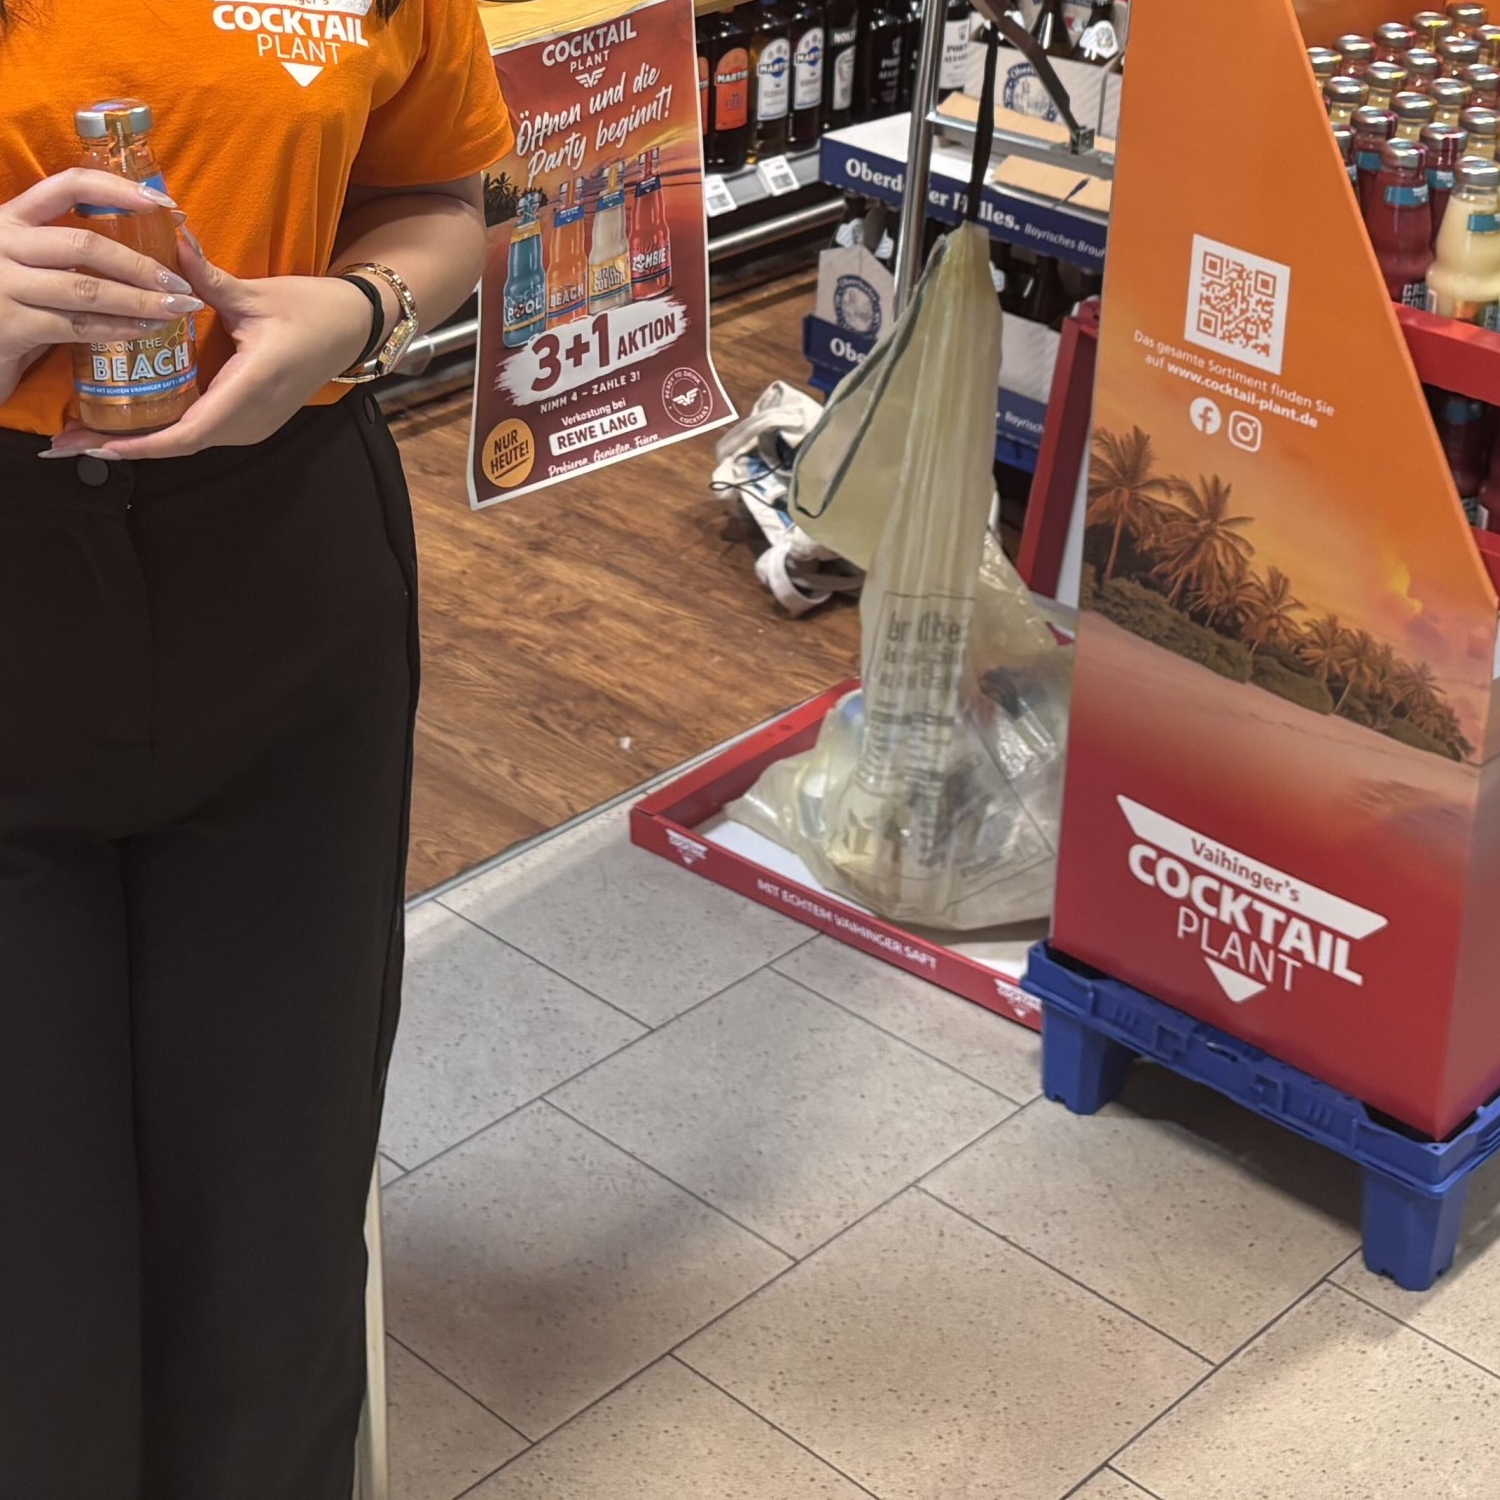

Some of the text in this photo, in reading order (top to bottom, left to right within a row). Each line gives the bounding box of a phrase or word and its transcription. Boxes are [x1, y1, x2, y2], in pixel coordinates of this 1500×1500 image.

[212, 3, 369, 48] COCKTAIL
[542, 18, 637, 67] COCKTAIL
[257, 33, 341, 66] PLANT
[570, 50, 610, 73] PLANT
[516, 62, 660, 156] Öffnen und die
[528, 84, 672, 188] Party beginnt!
[92, 342, 189, 381] BEACH
[115, 342, 133, 352] ON
[138, 337, 161, 349] THE
[531, 313, 675, 392] 3+1 AKTION
[540, 371, 640, 414] NIMM 4 ZAHLE 3!
[1133, 329, 1335, 417] Das gesamte Sortiment finden Sie
[1144, 350, 1319, 430] auf www.cocktail-plant.de
[557, 412, 638, 450] REWE LANG
[562, 399, 626, 427] Verkostung bei
[491, 442, 529, 474] HEUTE!
[494, 429, 518, 451] NUR
[1190, 836, 1301, 903] Vaihinger's
[757, 877, 938, 970] MIT ECHTEM VAIHINGER SAFT
[1127, 843, 1364, 988] COCKTAIL
[1177, 905, 1303, 993] PLANT
